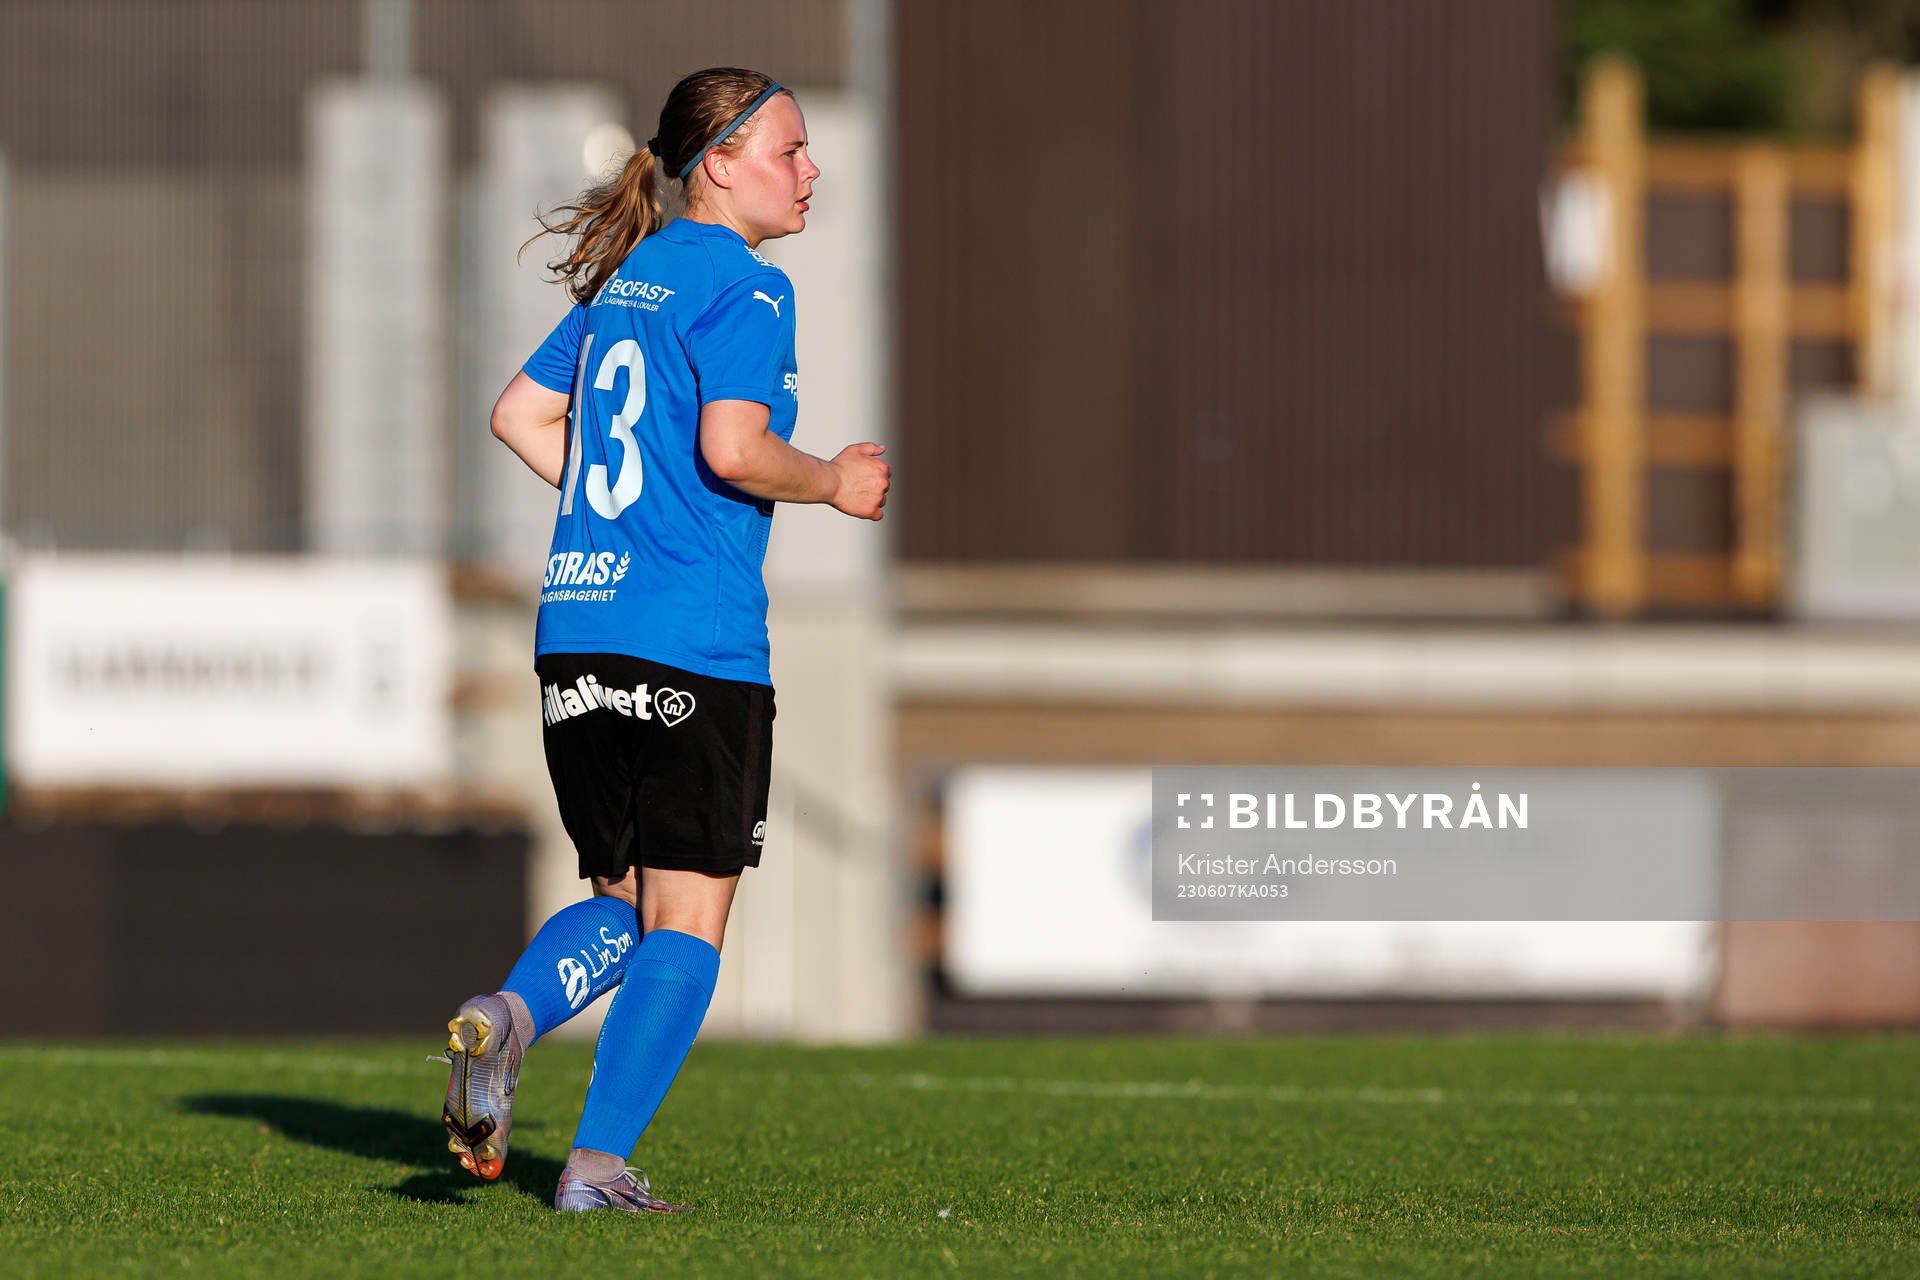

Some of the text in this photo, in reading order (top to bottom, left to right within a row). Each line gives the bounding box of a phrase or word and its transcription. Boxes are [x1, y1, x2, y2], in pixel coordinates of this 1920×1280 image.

[609, 279, 675, 302] BOFAST
[561, 334, 646, 520] 13
[580, 926, 634, 978] LinSon
